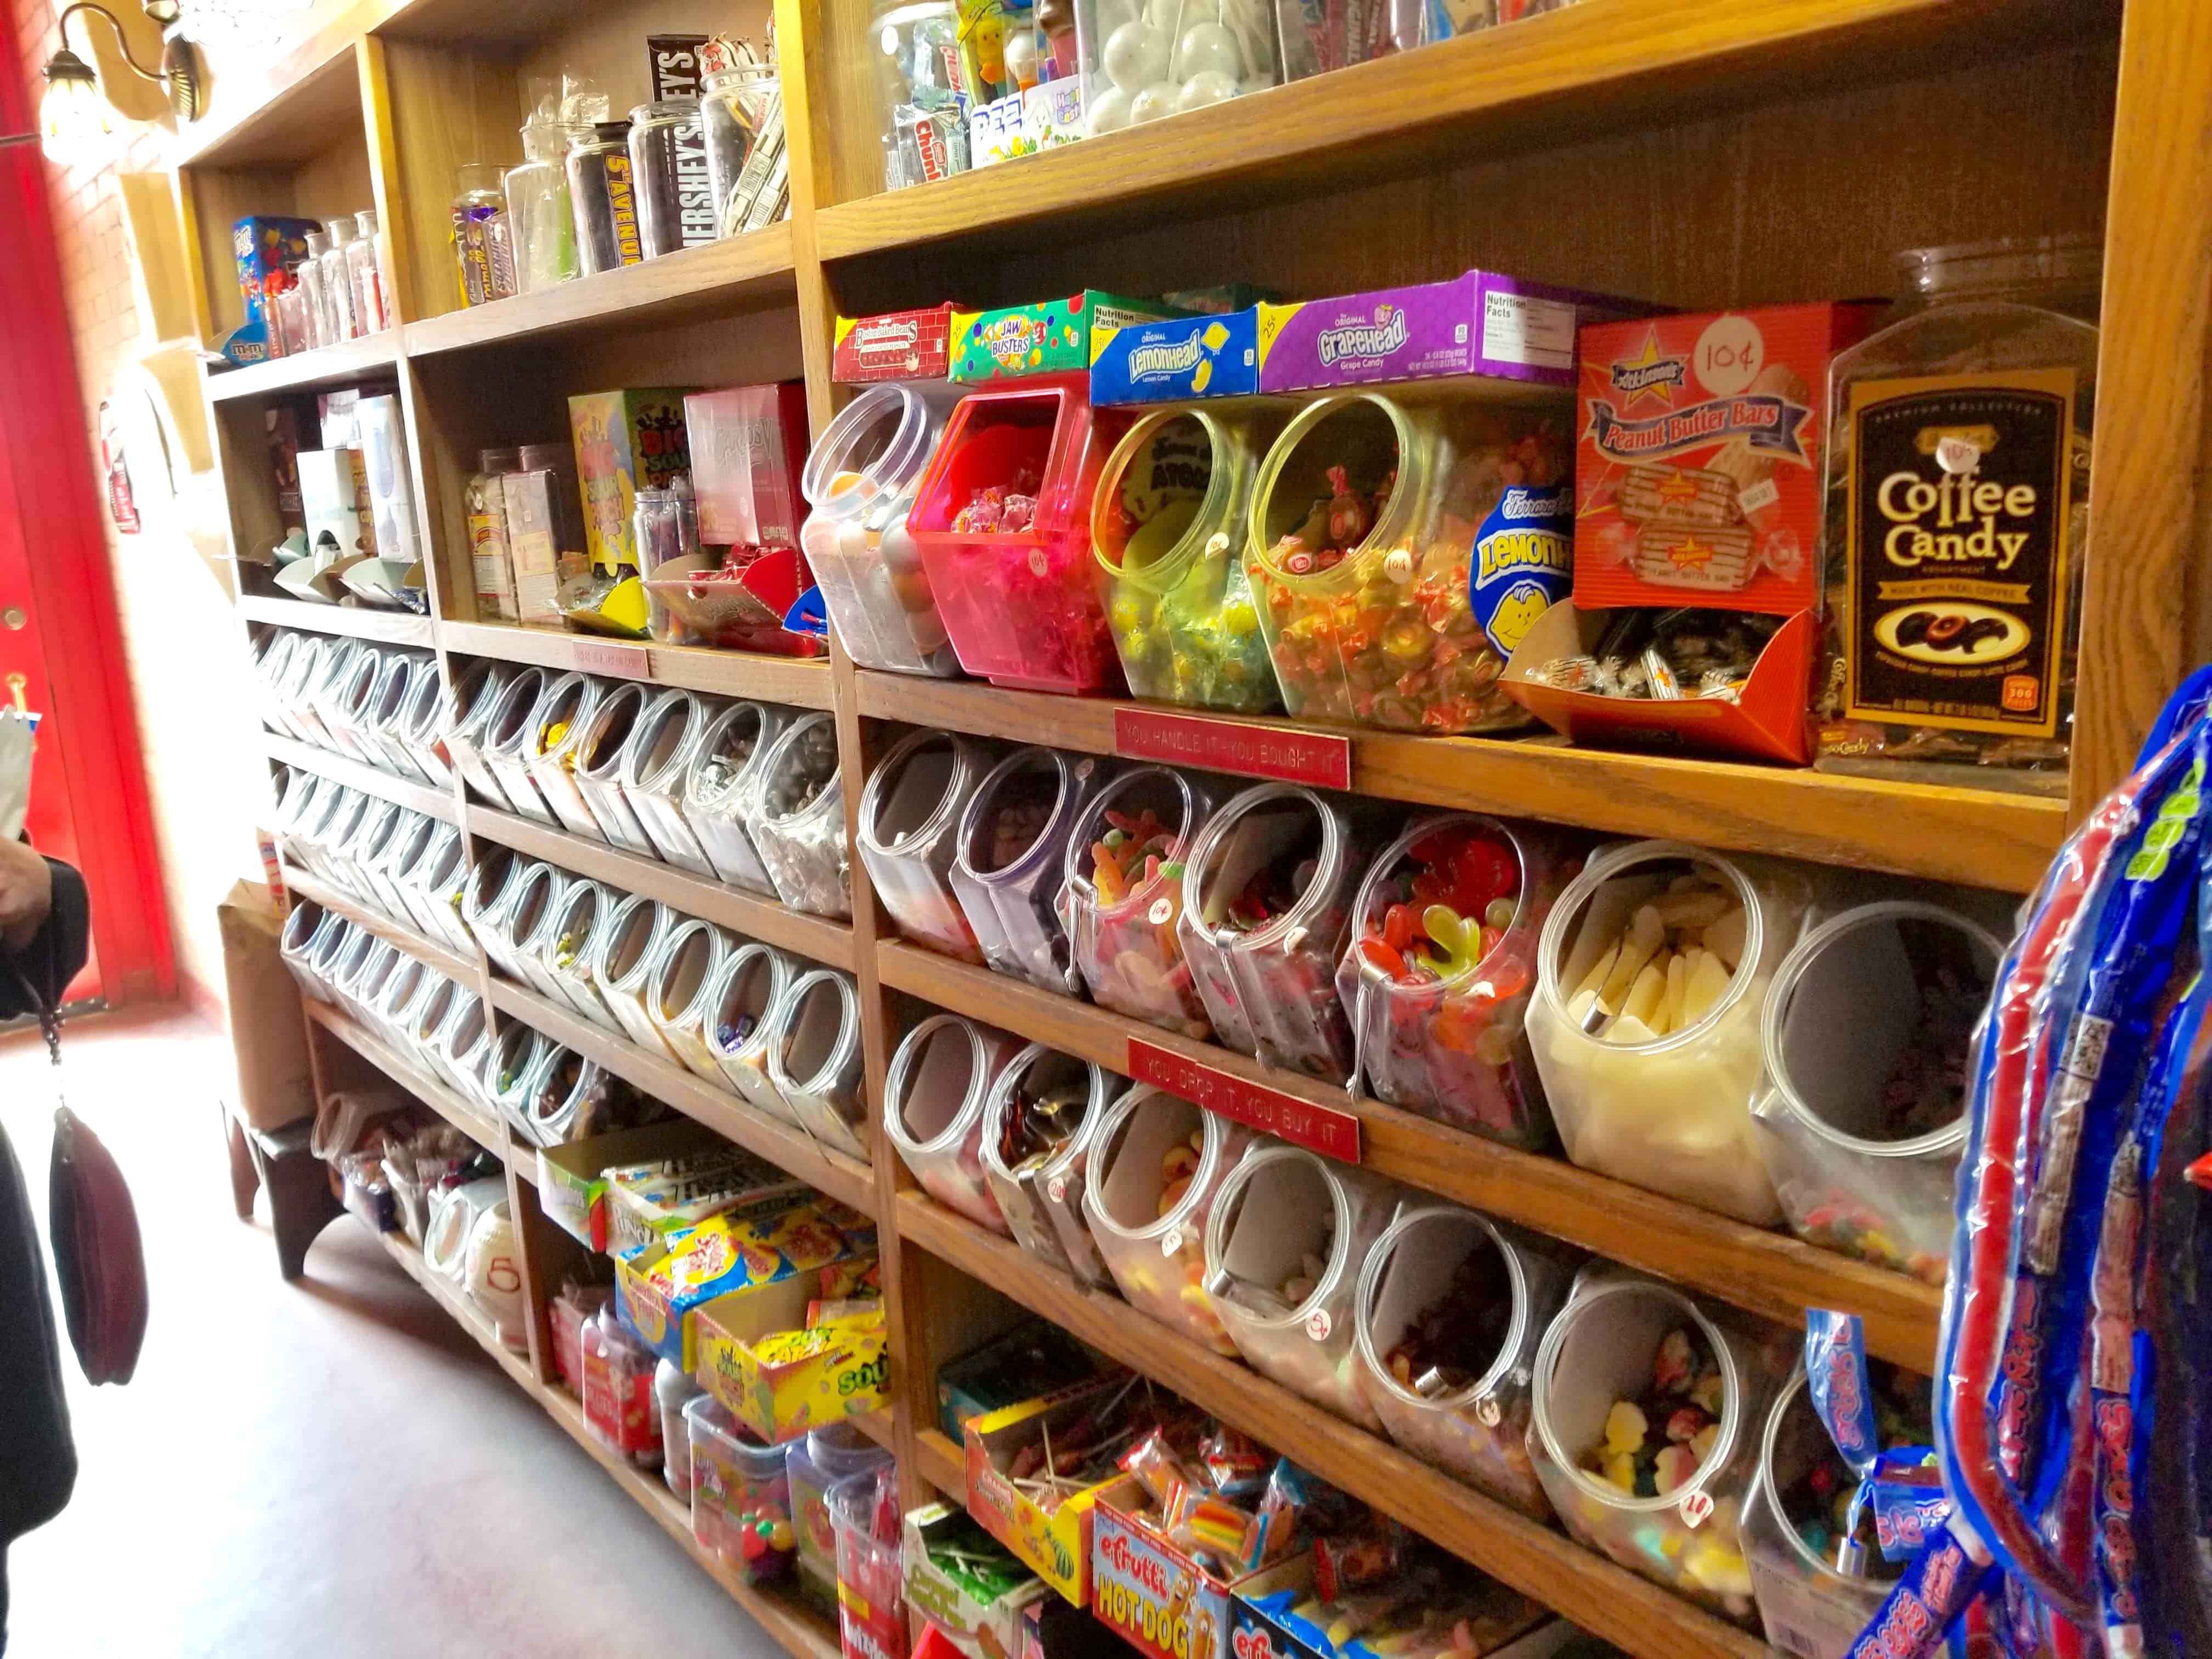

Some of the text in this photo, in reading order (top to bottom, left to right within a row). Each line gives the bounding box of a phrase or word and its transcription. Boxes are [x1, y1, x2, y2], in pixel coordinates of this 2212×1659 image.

[1486, 307, 1511, 318] Facts
[1487, 295, 1526, 309] Nutrition
[1095, 317, 1120, 328] Facts
[1096, 307, 1135, 321] Nutrition
[1334, 316, 1366, 326] ORIGINAL
[1001, 319, 1022, 337] JAW
[1141, 333, 1166, 343] ORIGINAL
[992, 337, 1030, 358] BUSTERS
[1706, 341, 1754, 371] 10¢
[1340, 357, 1384, 371] Grape Candy
[1603, 402, 1777, 452] Peanut Butter Bars
[1877, 472, 2036, 528] Coffee
[1884, 515, 2029, 571] Candy
[1124, 724, 1147, 743] YOU
[1153, 731, 1200, 753] HANDLE
[1259, 744, 1316, 769] BOUGHT
[1146, 1058, 1171, 1083] YOU
[1179, 1069, 1214, 1099] DROP
[1246, 1098, 1273, 1122] YOU
[1282, 1110, 1313, 1134] BUY
[1321, 1125, 1337, 1146] IT
[1099, 1535, 1169, 1600] efrutti
[1099, 1572, 1140, 1633] HOT
[1142, 1599, 1189, 1659] DOG
